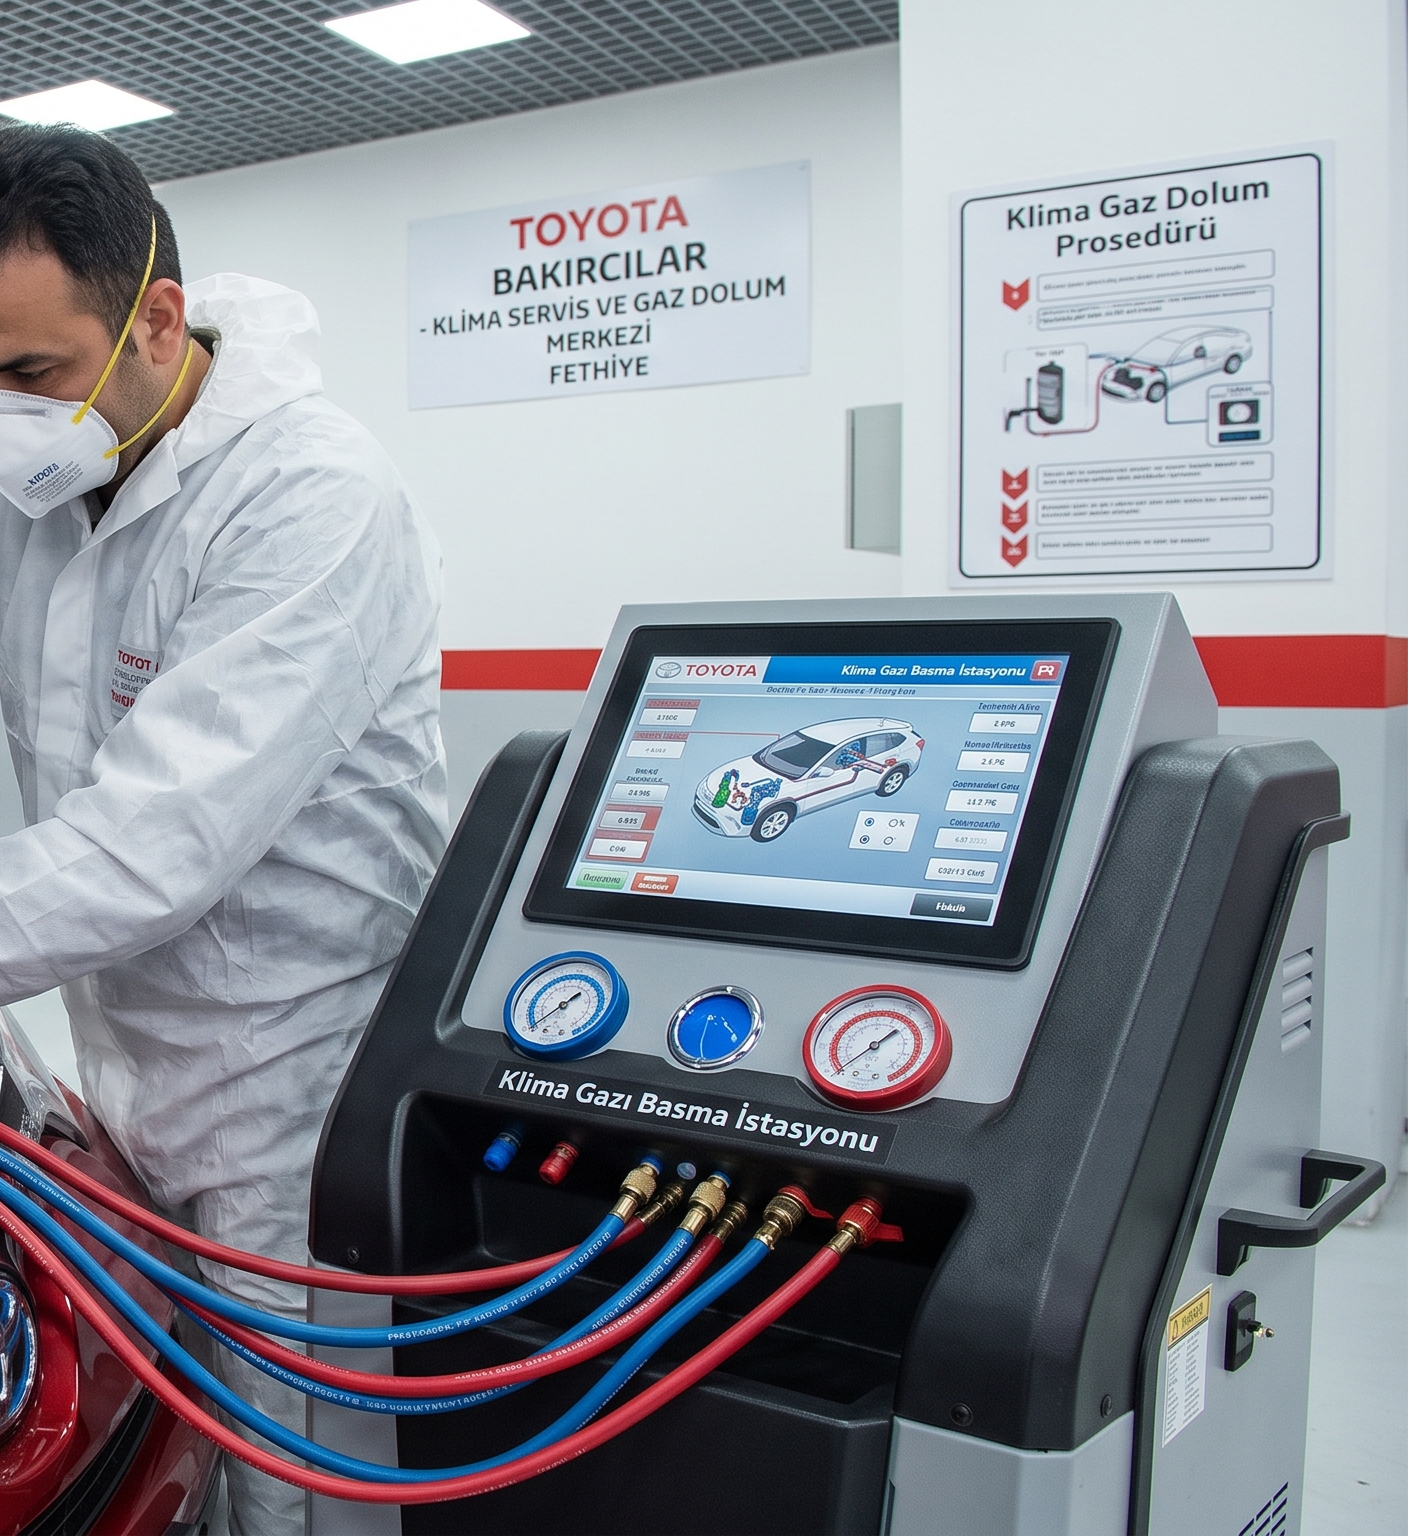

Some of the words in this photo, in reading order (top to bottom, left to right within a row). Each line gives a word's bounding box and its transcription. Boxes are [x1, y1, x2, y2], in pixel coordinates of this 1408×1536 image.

[510, 194, 689, 250] TOYOTA
[1007, 200, 1090, 231] Klima
[1099, 191, 1157, 219] Gaz
[1167, 180, 1270, 211] Dolum
[1056, 216, 1217, 257] Prosedürü
[493, 241, 707, 295] BAKIRCILAR
[433, 308, 502, 335] KLİMA
[508, 296, 590, 327] SERVİS
[597, 295, 627, 316] VE
[634, 288, 685, 313] GAZ
[693, 275, 786, 307] DOLUM
[546, 318, 651, 353] MERKEZİ
[549, 356, 649, 384] FETHİYE
[685, 664, 757, 677] TOYOTA
[841, 664, 877, 676] Klima
[880, 665, 907, 676] Gazı
[911, 665, 955, 676] Basma
[959, 663, 1026, 679] İstasyonu
[497, 1069, 568, 1099] Klima
[575, 1081, 633, 1111] Gazı
[637, 1092, 727, 1127] Basma
[735, 1101, 879, 1152] İstasyonu
